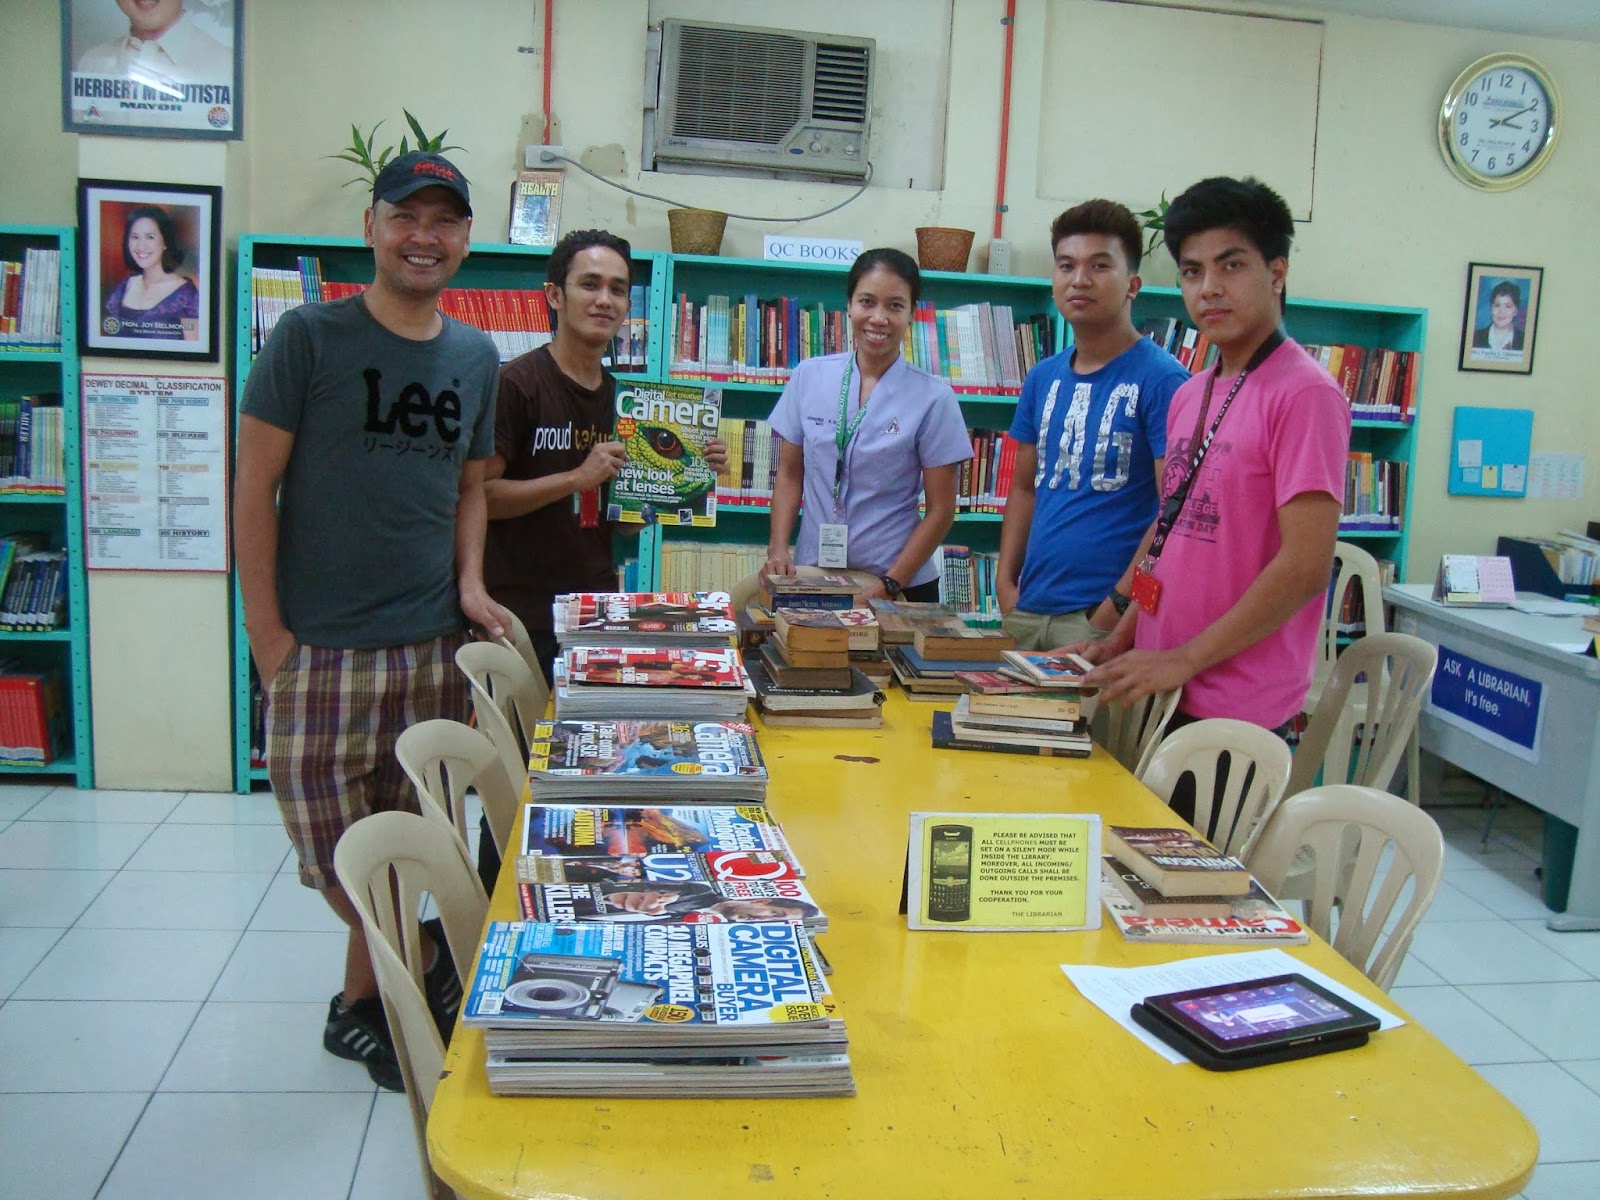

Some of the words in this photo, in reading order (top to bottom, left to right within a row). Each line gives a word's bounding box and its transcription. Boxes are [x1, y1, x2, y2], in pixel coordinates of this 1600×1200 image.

[1481, 78, 1492, 91] 11
[1500, 73, 1513, 88] 12
[75, 78, 139, 100] HERBERT
[1521, 82, 1526, 95] 1
[120, 102, 183, 111] MAYOR
[1465, 92, 1478, 106] 10
[1529, 98, 1538, 112] 2
[1459, 112, 1468, 125] 9
[1530, 120, 1538, 133] 3
[1460, 132, 1468, 146] 8
[1522, 140, 1530, 153] 4
[1471, 150, 1479, 163] 7
[1488, 157, 1496, 170] 6
[1506, 154, 1515, 166] 5
[521, 182, 558, 195] HEALTH
[769, 242, 794, 259] QC
[800, 245, 859, 261] BOOKS
[86, 380, 113, 388] DEWEY
[115, 380, 149, 389] DECIMAL
[157, 382, 221, 391] CLASSIFICATION
[634, 388, 665, 401] Digital
[363, 368, 461, 442] Lee
[616, 391, 719, 427] Camera
[532, 421, 572, 456] proud
[700, 428, 716, 436] great
[617, 468, 643, 478] new
[647, 468, 674, 482] look
[615, 479, 629, 491] at
[633, 479, 675, 495] lenses
[1443, 657, 1461, 677] ASK
[1468, 668, 1475, 683] A
[1478, 670, 1530, 708] LIBRARIAN,
[1465, 689, 1478, 707] It's
[1479, 696, 1501, 717] free.
[581, 724, 599, 732] of
[599, 724, 617, 739] Take
[693, 722, 737, 776] Camera
[574, 808, 596, 846] AUTUMN
[710, 808, 738, 852] Photograp
[733, 823, 763, 851] Practical
[643, 853, 693, 882] U2
[713, 852, 787, 881] Q
[571, 884, 591, 899] THE
[733, 881, 751, 897] FREE
[760, 881, 779, 897] WAYS
[772, 881, 802, 897] 100
[667, 925, 692, 940] 10
[1121, 915, 1302, 935] Camera
[643, 925, 668, 980] COMPACTS
[728, 924, 774, 1013] CAMERA
[761, 925, 807, 1002] DIGITAL
[667, 941, 695, 1005] MEGAPIXEL
[717, 983, 738, 1021] BUYER
[666, 1008, 689, 1020] 150
